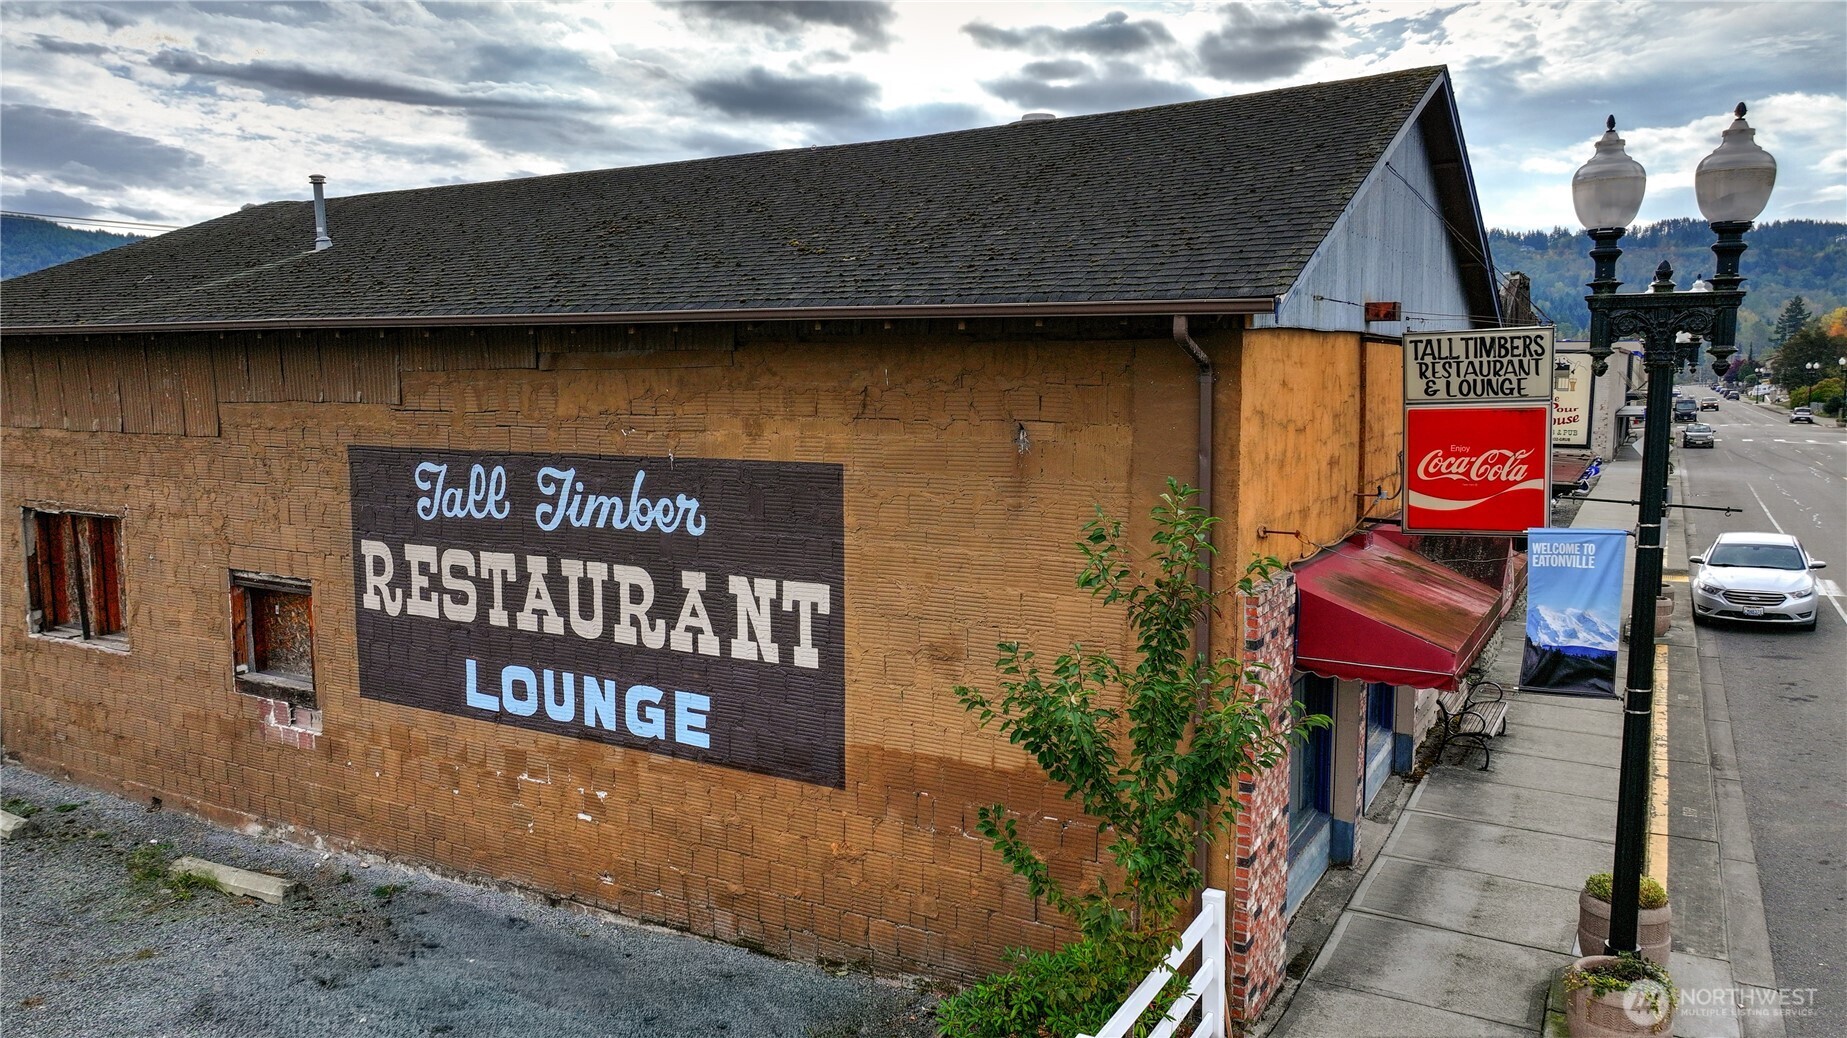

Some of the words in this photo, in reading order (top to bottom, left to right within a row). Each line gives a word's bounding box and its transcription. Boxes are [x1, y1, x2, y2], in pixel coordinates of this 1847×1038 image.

[1409, 338, 1460, 361] TALL
[1460, 335, 1545, 359] TIMBERS
[1416, 358, 1543, 379] RESTAURANT
[1424, 380, 1440, 397] &
[1446, 378, 1529, 397] LOUNGE
[1450, 445, 1470, 453] Enjoy
[1417, 448, 1535, 481] Coca-Cola
[415, 461, 510, 521] Tall
[536, 466, 706, 536] Timber
[1532, 543, 1580, 554] WELCOME
[1582, 543, 1596, 555] TO
[1532, 555, 1595, 568] EATONVILLE
[360, 539, 831, 669] RESTAURANT
[465, 659, 711, 749] LOUNGE
